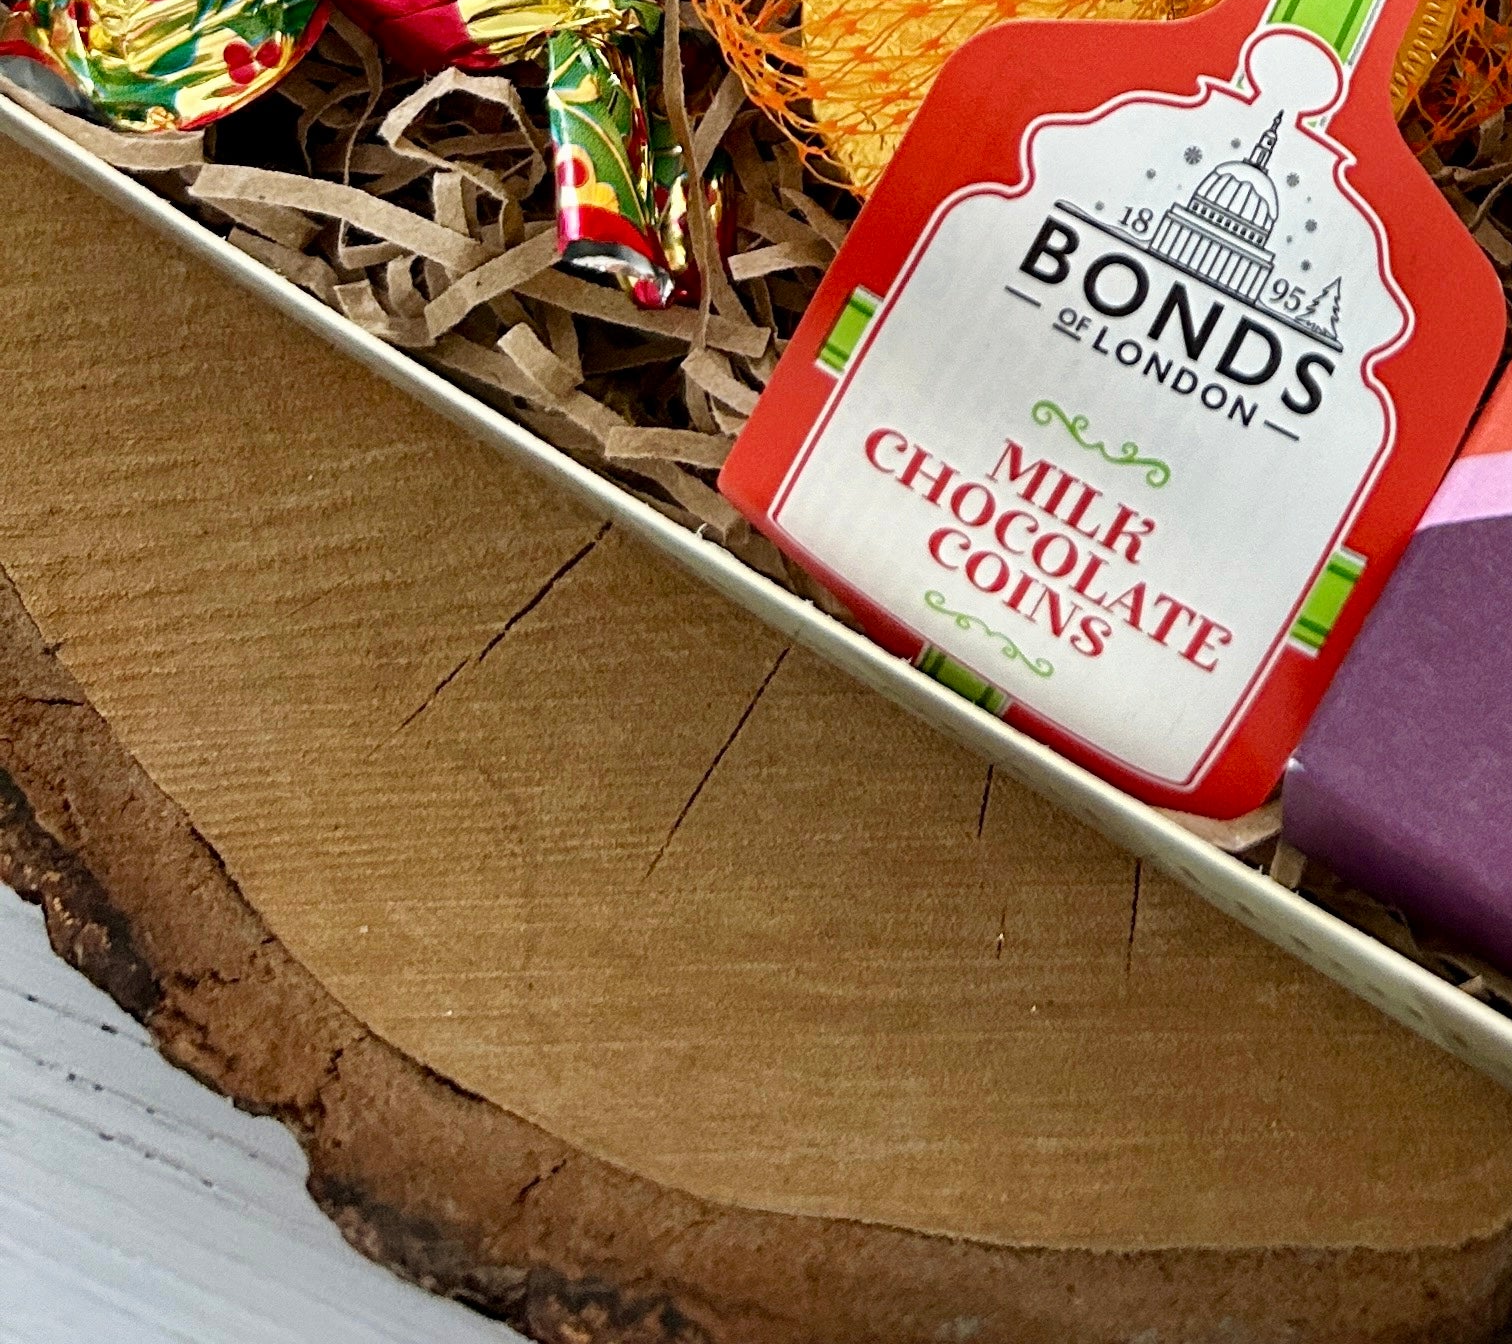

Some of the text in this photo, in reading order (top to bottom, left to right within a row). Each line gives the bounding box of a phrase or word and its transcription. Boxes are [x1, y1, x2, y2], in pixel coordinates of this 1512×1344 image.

[1018, 214, 1337, 416] BONDS
[1118, 205, 1307, 312] 18 95
[1056, 306, 1259, 427] OF LONDON
[863, 426, 1234, 674] CHOCOLATE
[985, 437, 1157, 565] MILK
[927, 525, 1114, 658] COINS
